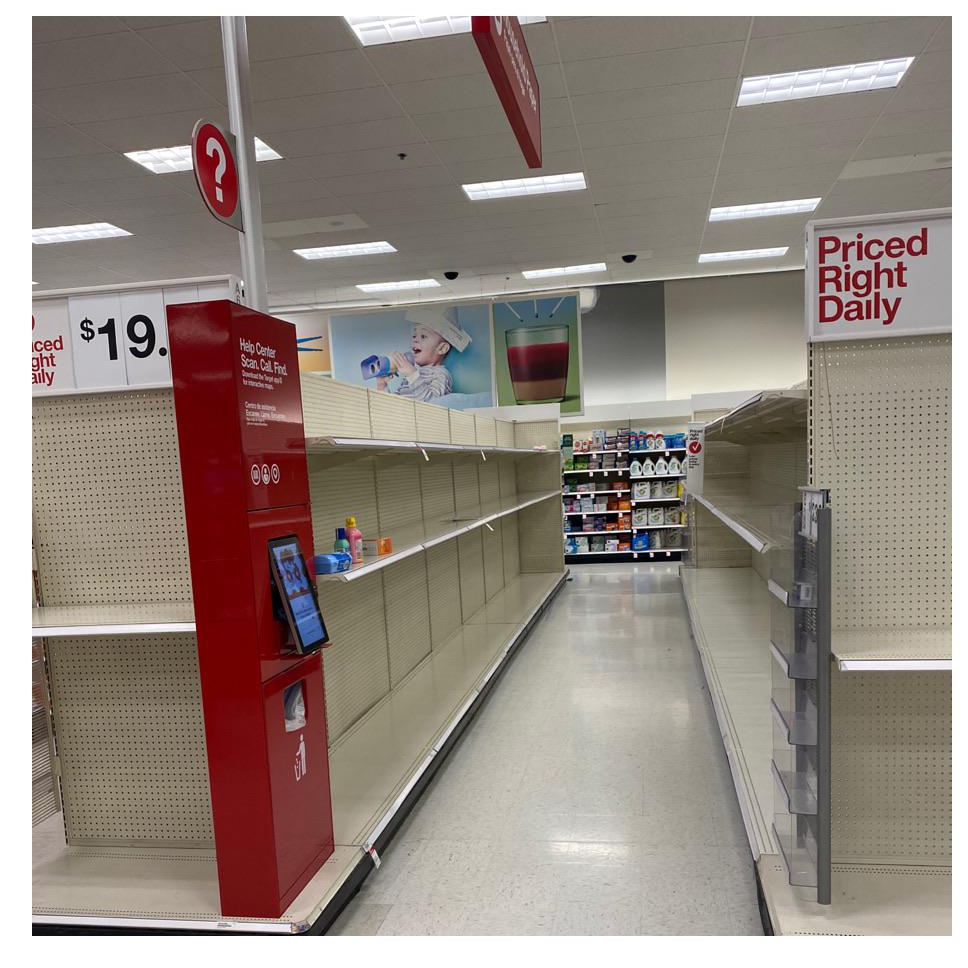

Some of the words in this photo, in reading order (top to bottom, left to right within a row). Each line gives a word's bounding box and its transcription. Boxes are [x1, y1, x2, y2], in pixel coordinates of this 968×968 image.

[818, 227, 928, 264] Priced
[818, 261, 907, 298] Right
[818, 291, 902, 325] Daily
[240, 337, 255, 356] Help
[255, 342, 276, 359] Center
[241, 353, 259, 370] Scan.
[260, 358, 274, 373] Call.
[274, 361, 288, 376] Find.
